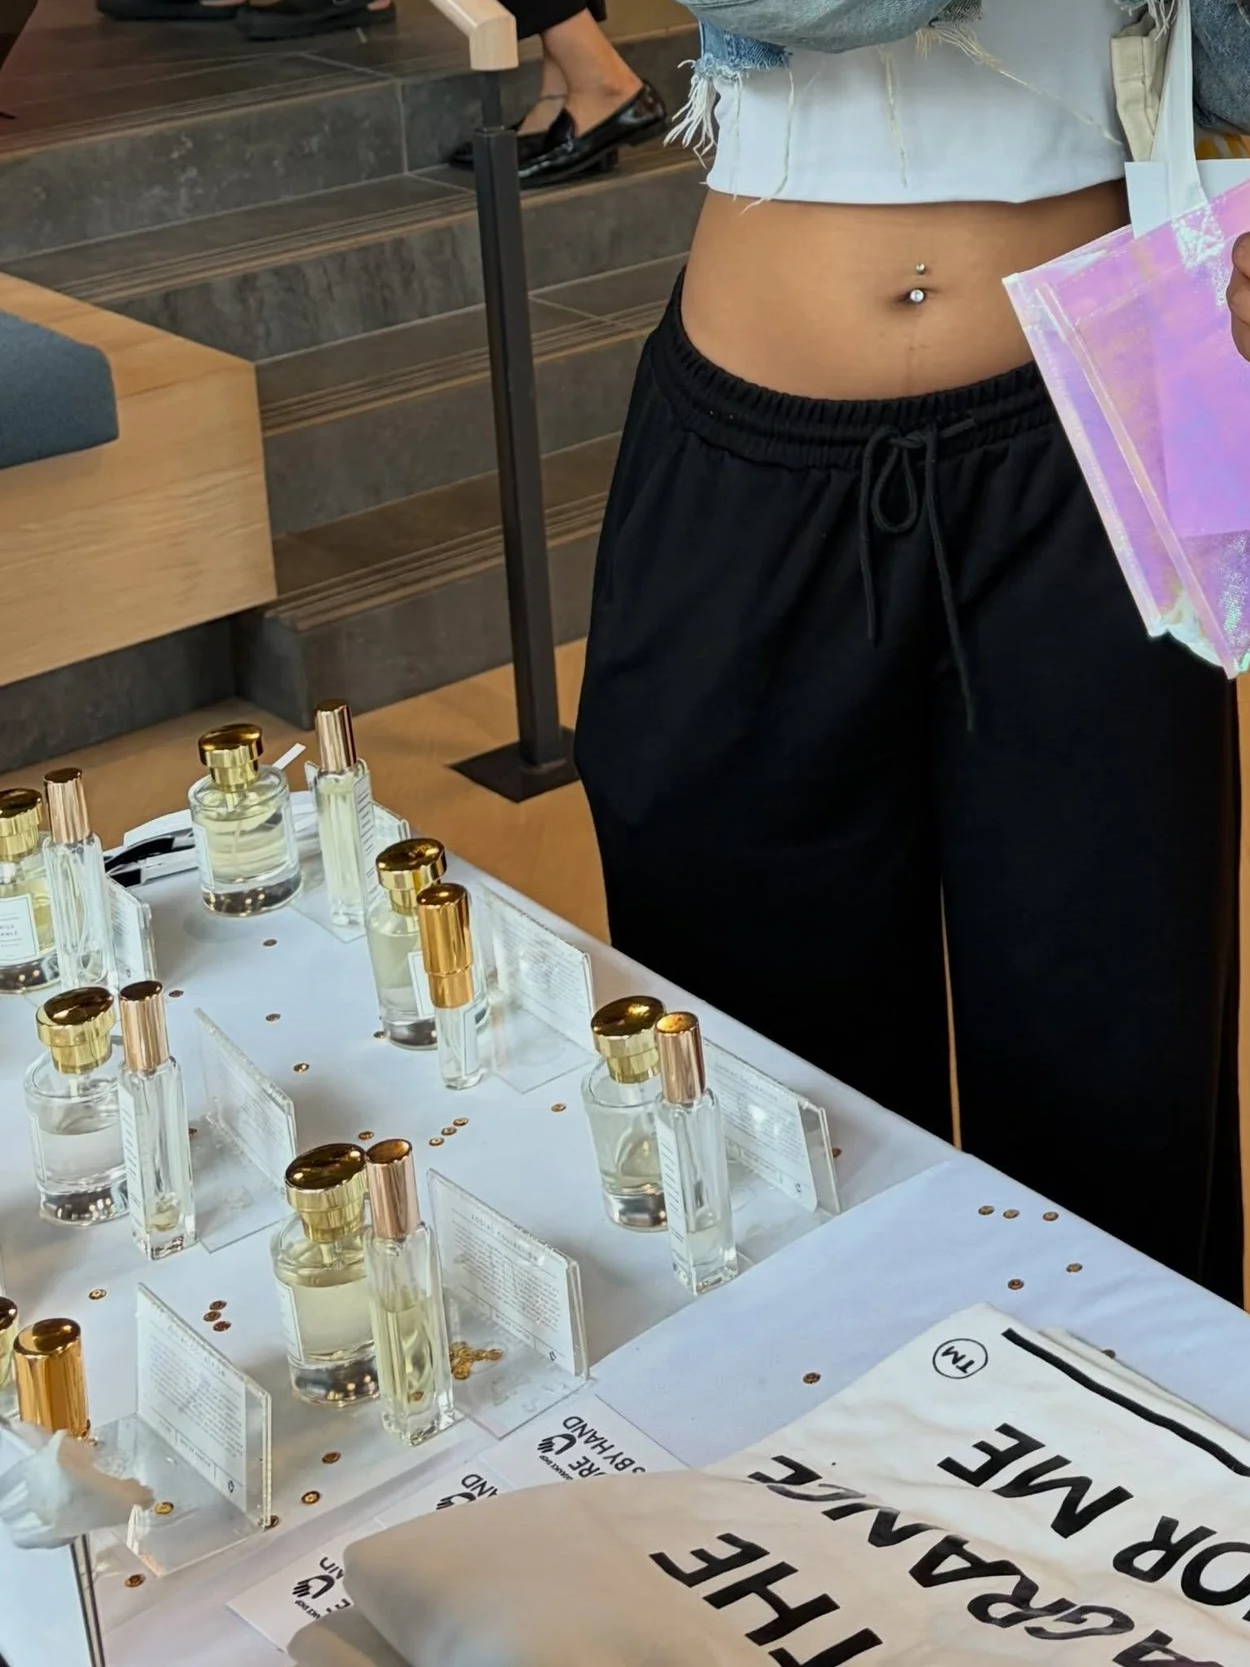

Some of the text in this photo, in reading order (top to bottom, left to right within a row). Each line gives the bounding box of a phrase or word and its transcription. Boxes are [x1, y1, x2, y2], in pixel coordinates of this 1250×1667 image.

[941, 1346, 975, 1374] TM
[562, 1416, 635, 1471] BY HAND
[568, 1456, 606, 1478] RE
[937, 1423, 1134, 1539] ME
[648, 1533, 883, 1667] THE
